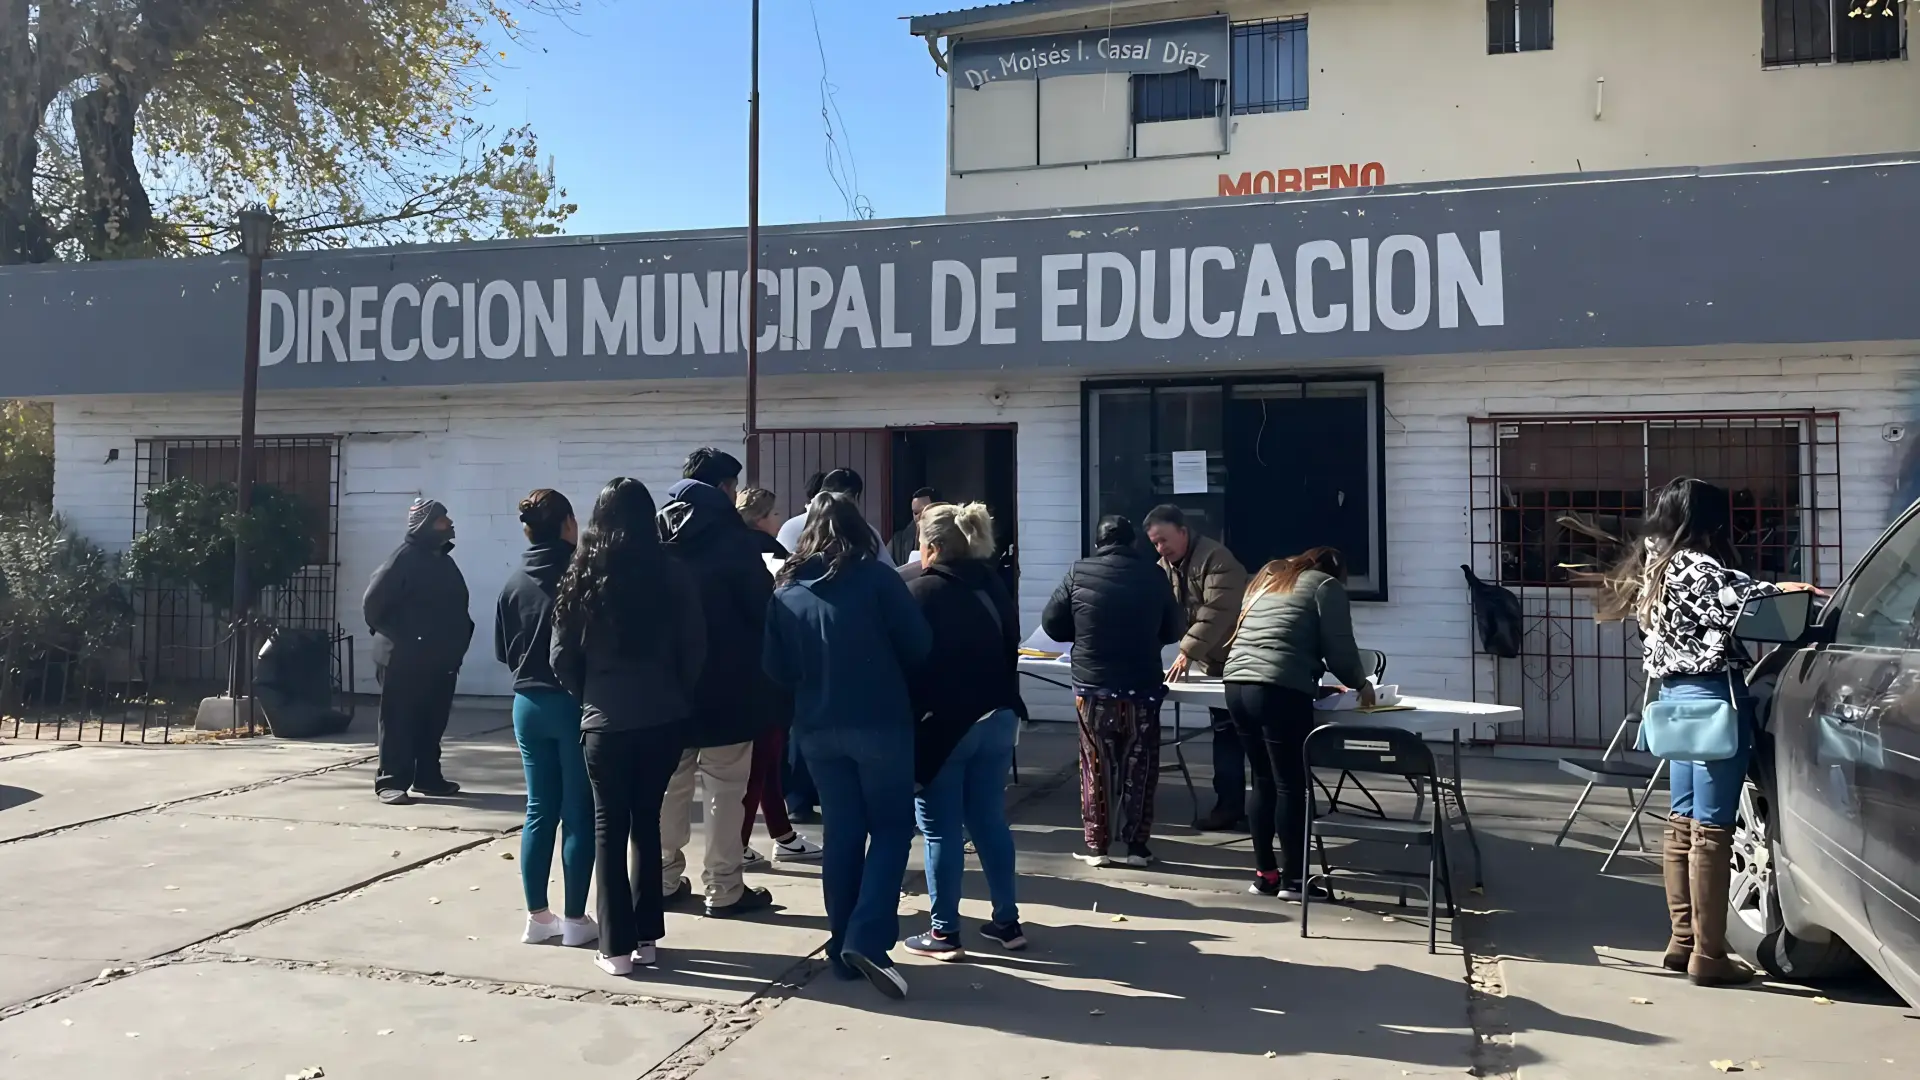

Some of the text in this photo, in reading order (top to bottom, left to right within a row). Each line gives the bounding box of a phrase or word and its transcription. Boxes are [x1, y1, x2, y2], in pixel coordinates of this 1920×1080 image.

[965, 68, 996, 89] Dr.
[998, 43, 1071, 77] Moisés
[1097, 37, 1152, 60] Casal
[1162, 41, 1211, 69] Díaz
[1218, 162, 1385, 197] MORENO
[260, 229, 1505, 367] DIRECCION MUNICIPAL DE EDUCACION
